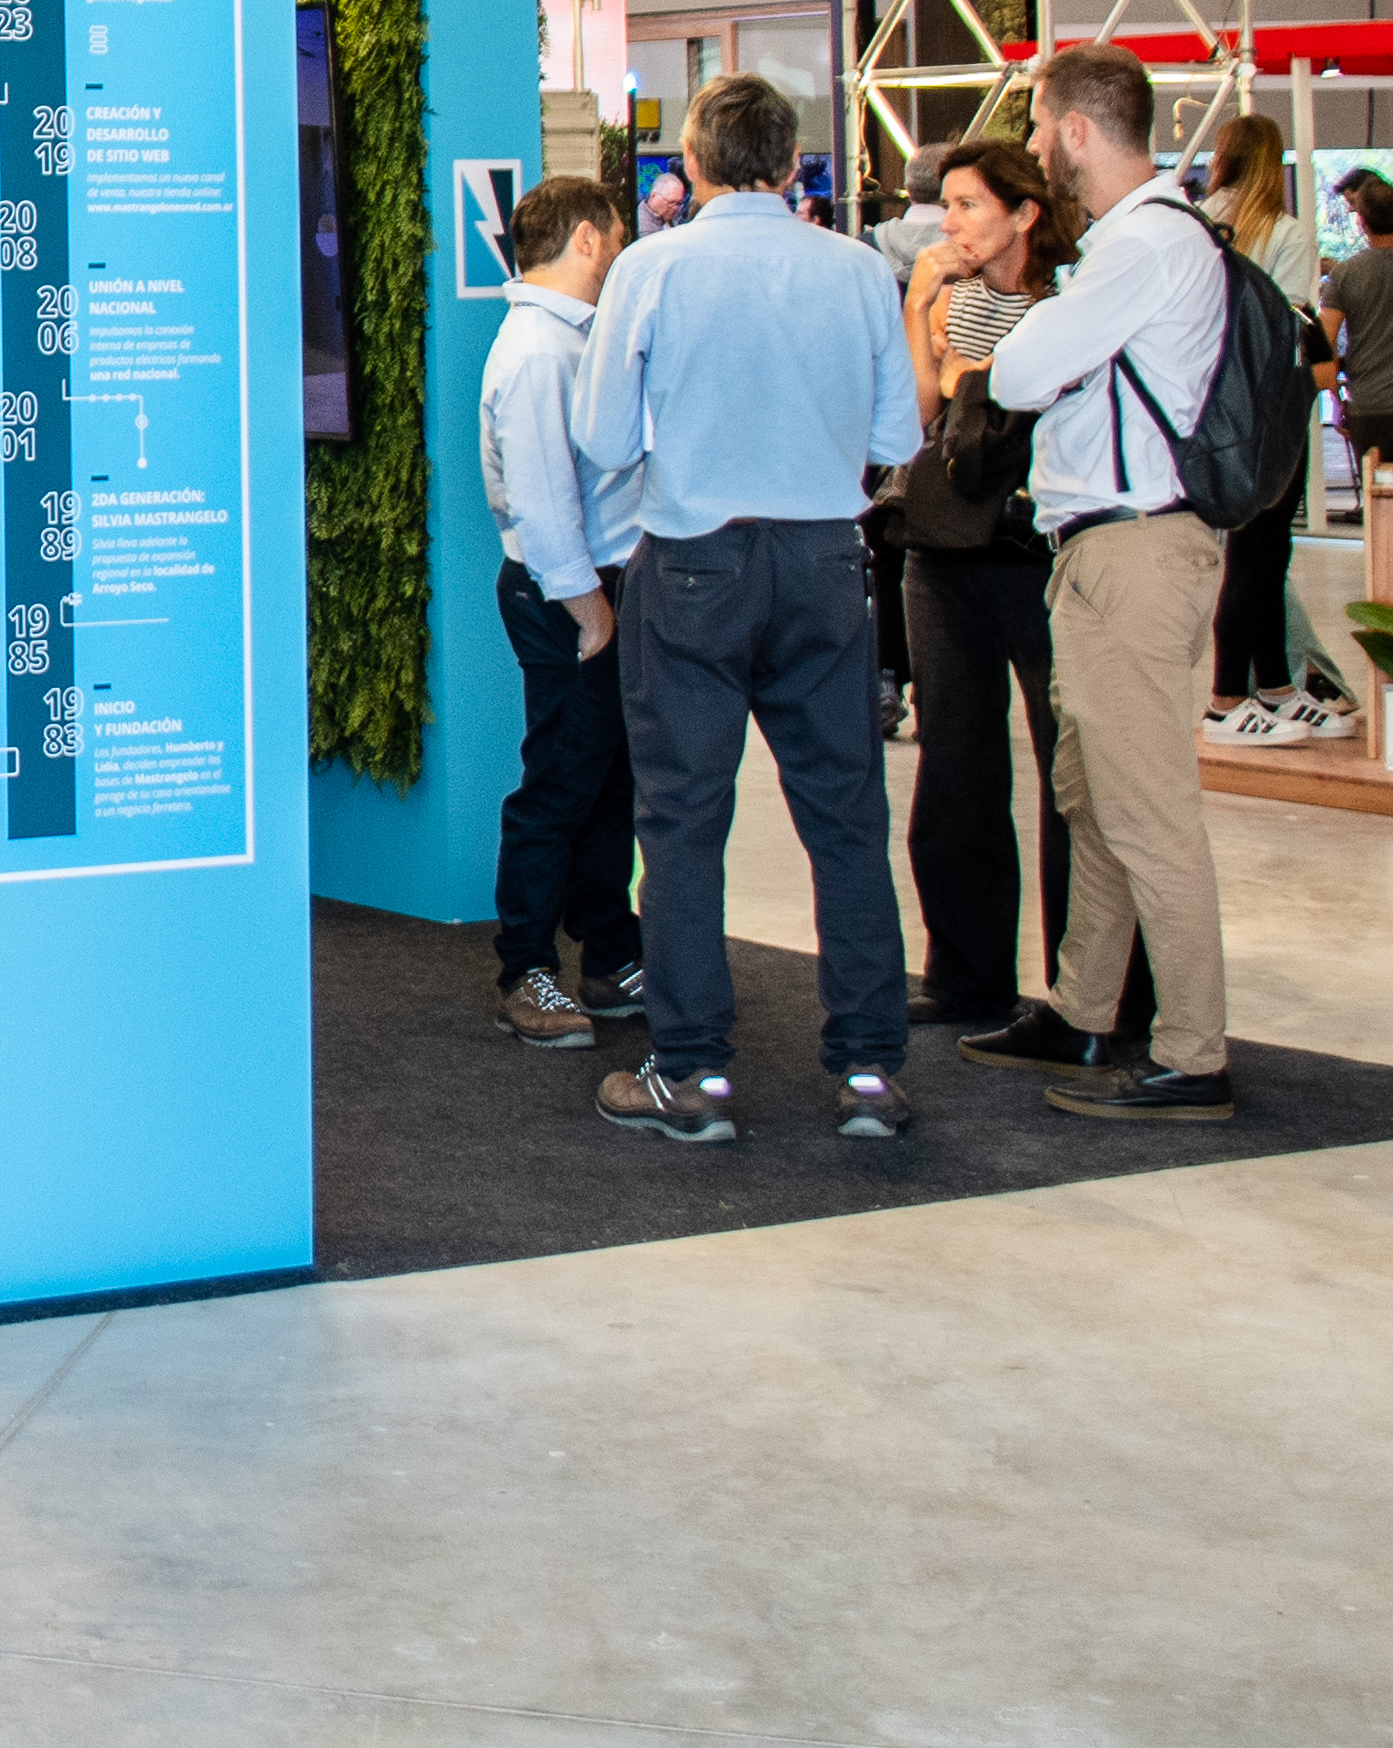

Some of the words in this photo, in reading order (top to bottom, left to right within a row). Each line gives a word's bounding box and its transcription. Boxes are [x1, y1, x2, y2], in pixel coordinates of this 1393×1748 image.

[33, 106, 75, 139] 20
[86, 104, 149, 120] CREACIÓN
[152, 108, 161, 120] Y
[86, 128, 169, 141] DESARROLLO
[34, 142, 75, 175] 19
[87, 150, 103, 162] DE
[107, 149, 139, 162] SITIO
[142, 150, 169, 162] WEB
[89, 278, 129, 293] UNIÓN
[132, 281, 145, 292] A
[148, 280, 184, 293] NIVEL
[37, 285, 78, 319] 20
[89, 302, 156, 314] NACIONAL
[38, 321, 79, 355] 06
[40, 491, 81, 525] 19
[91, 493, 117, 507] 2DA
[120, 487, 205, 505] GENERACIÓN:
[92, 514, 131, 527] SILVIA
[135, 510, 228, 526] MASTRANGELO
[40, 528, 81, 561] 89
[93, 583, 128, 595] Arroyo
[8, 604, 49, 638] 19
[8, 640, 49, 675] 85
[43, 686, 84, 721] 19
[94, 700, 135, 715] INICIO
[94, 725, 102, 736] Y
[106, 717, 182, 736] FUNDACIÓN
[44, 723, 84, 757] 83
